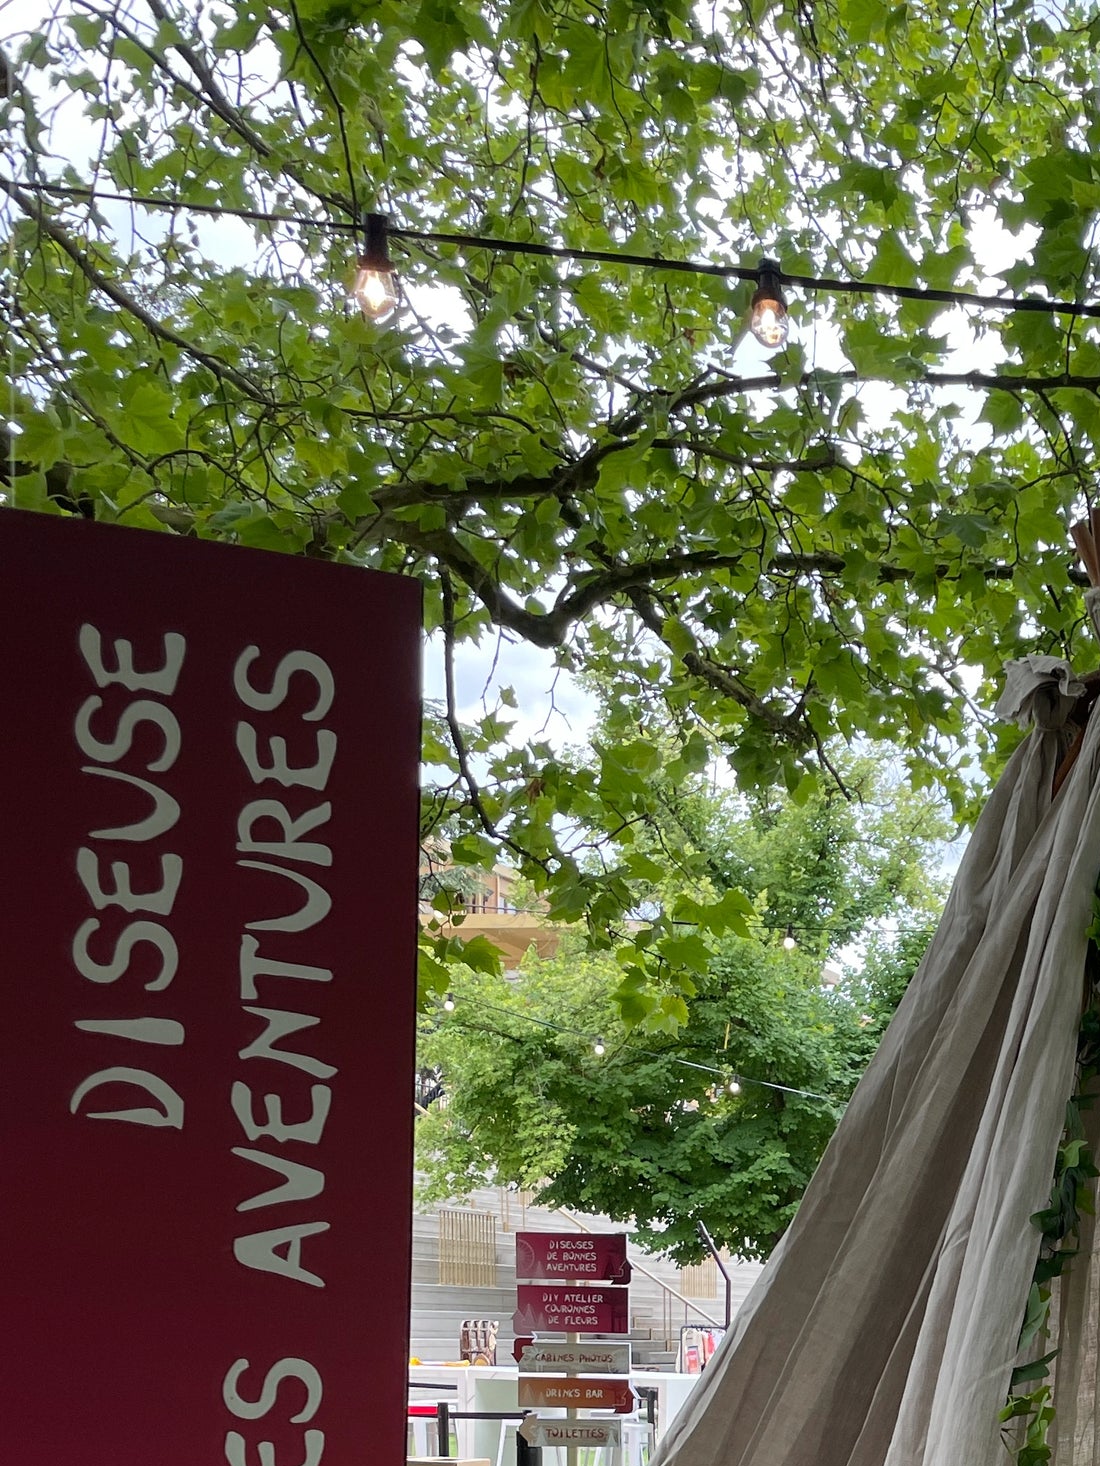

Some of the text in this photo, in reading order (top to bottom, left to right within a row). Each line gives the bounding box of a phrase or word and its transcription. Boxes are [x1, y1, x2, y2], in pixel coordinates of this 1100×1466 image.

[71, 623, 186, 1130] DISEUSE
[231, 645, 338, 1288] AVENTURES
[549, 1240, 594, 1249] DISEUSES
[546, 1252, 597, 1261] DE BONNES
[546, 1263, 597, 1272] AVENTURES
[542, 1293, 604, 1303] DIY ATELIER
[544, 1304, 596, 1314] COURONNES
[548, 1315, 598, 1325] DE FLEURS
[535, 1353, 614, 1363] CABINES PHOTOS
[546, 1388, 604, 1398] DRINKS BAR
[546, 1428, 605, 1438] TOILETTES
